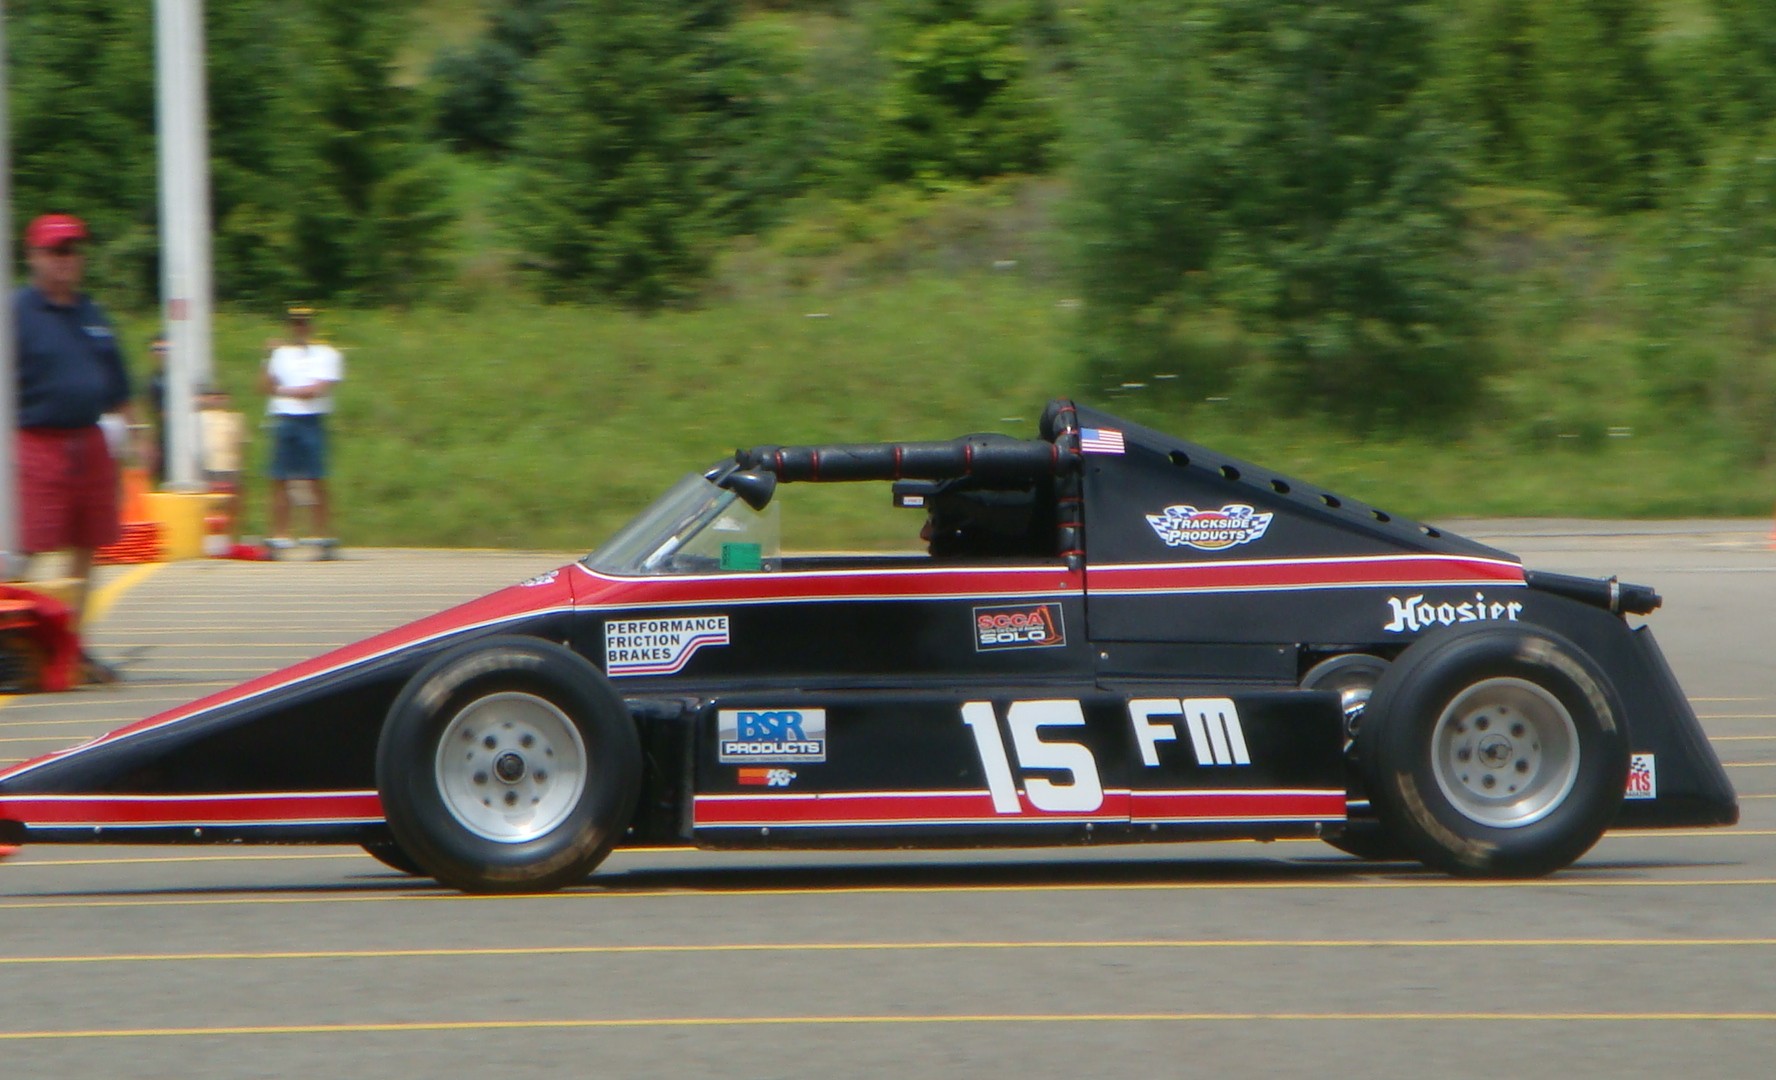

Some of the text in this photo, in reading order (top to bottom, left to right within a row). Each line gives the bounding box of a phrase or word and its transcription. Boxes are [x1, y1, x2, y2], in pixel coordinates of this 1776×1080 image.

[1171, 518, 1249, 530] TRACKSIDE
[1168, 530, 1246, 541] PRODUCTS
[1384, 591, 1523, 632] Hoosier
[607, 618, 727, 635] PERFORMANCE
[977, 611, 1045, 629] SCCA
[608, 634, 680, 648] FRICTION
[980, 630, 1046, 644] SOLO
[608, 648, 672, 661] BRAKES
[737, 711, 807, 741] BSR
[1128, 698, 1251, 766] FM
[726, 742, 820, 754] PRODUCTS
[961, 699, 1104, 814] 15
